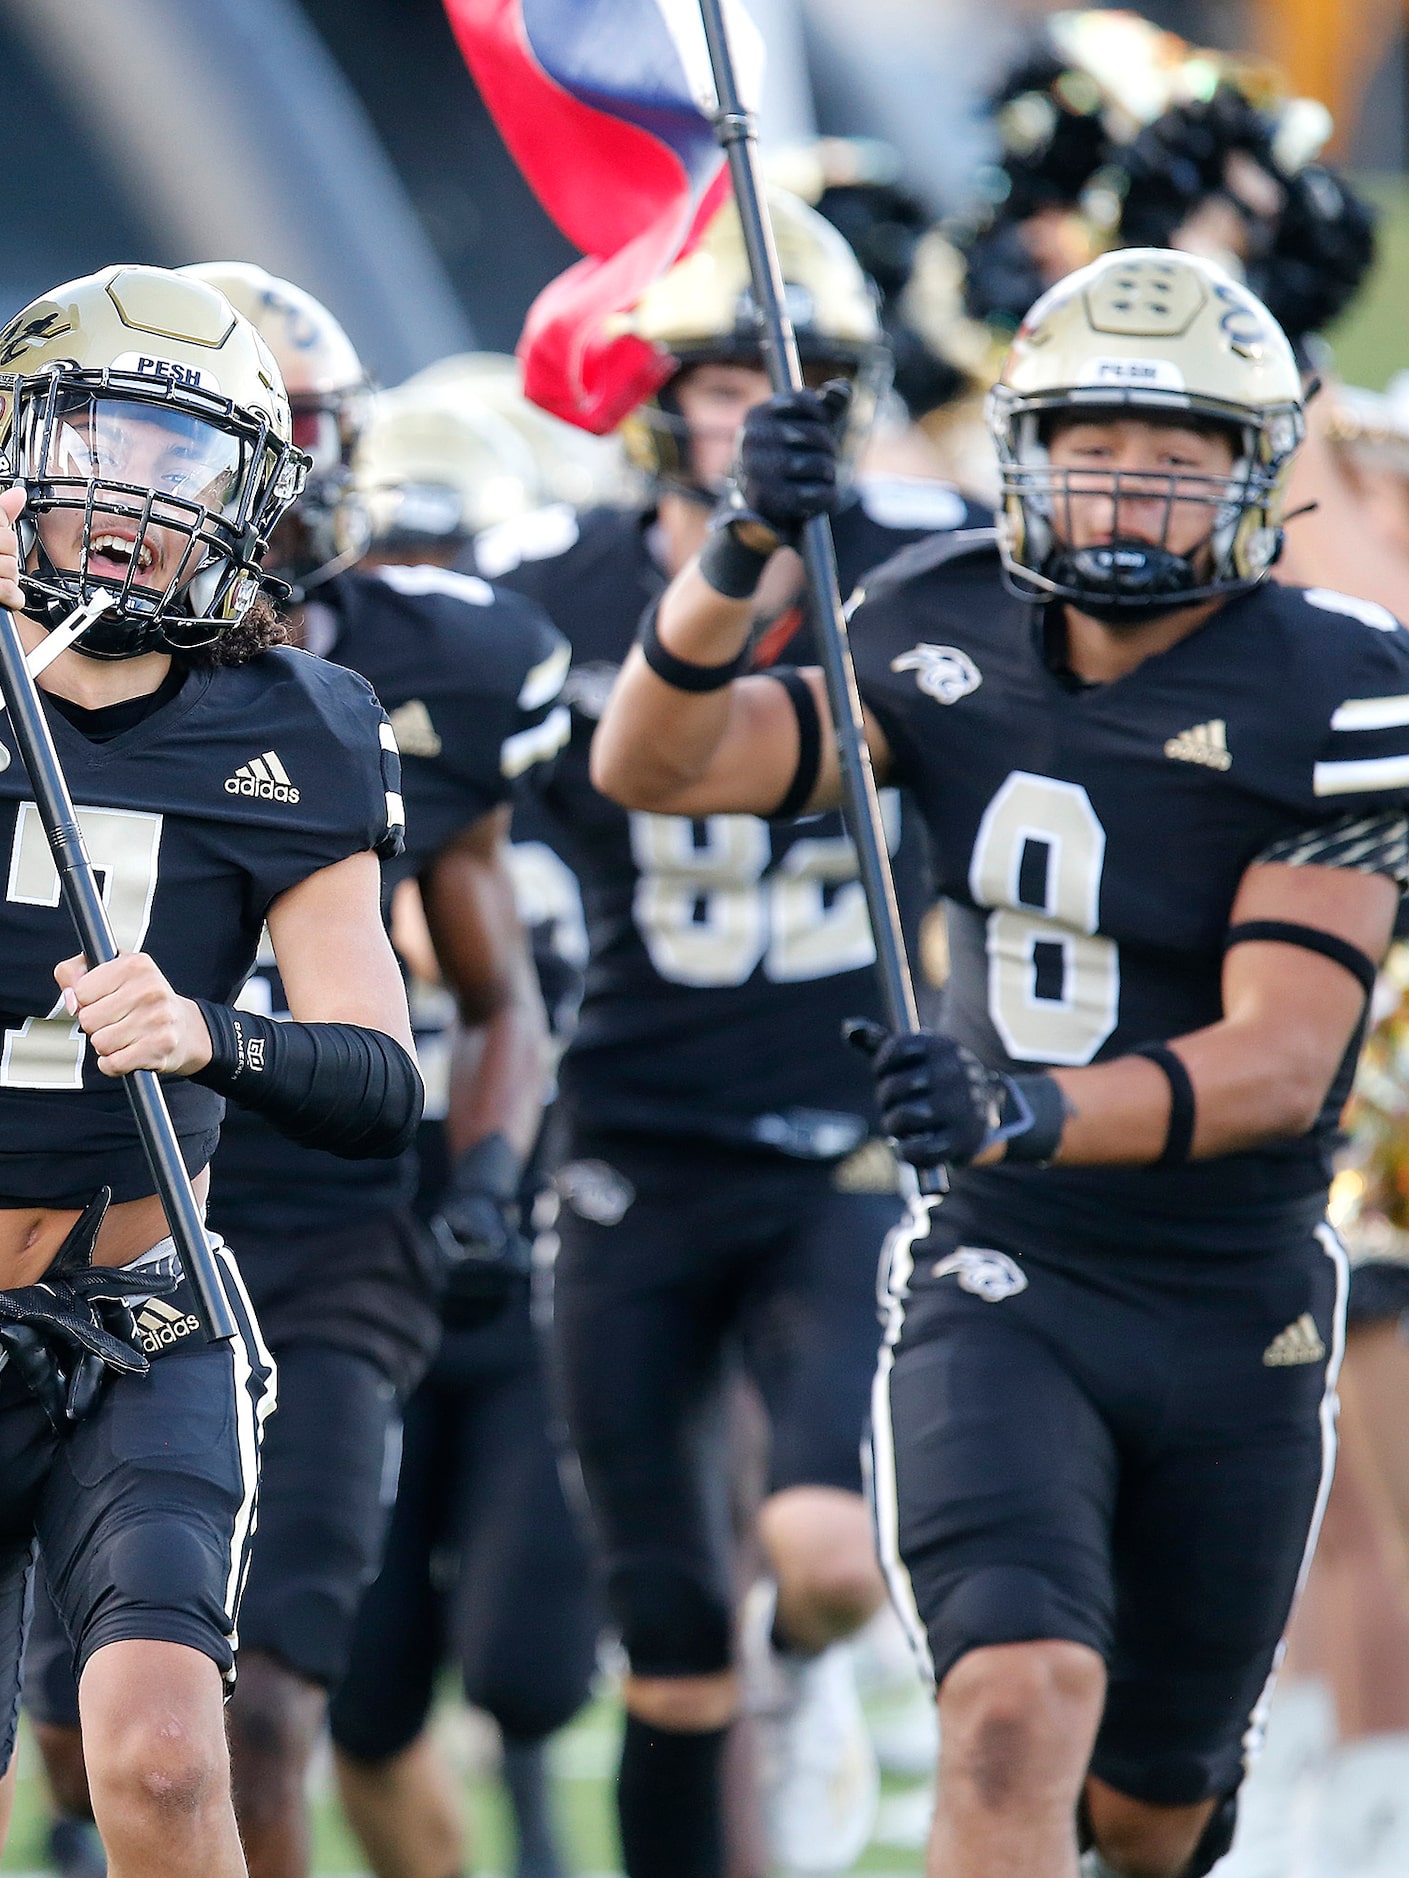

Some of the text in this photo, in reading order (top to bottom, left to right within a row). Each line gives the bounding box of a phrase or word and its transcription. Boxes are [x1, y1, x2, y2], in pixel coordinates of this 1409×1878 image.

[137, 357, 201, 386] PESH
[224, 776, 301, 804] adidas
[968, 769, 1121, 1066] 8
[0, 801, 164, 1089] 7
[143, 1313, 200, 1352] didas
